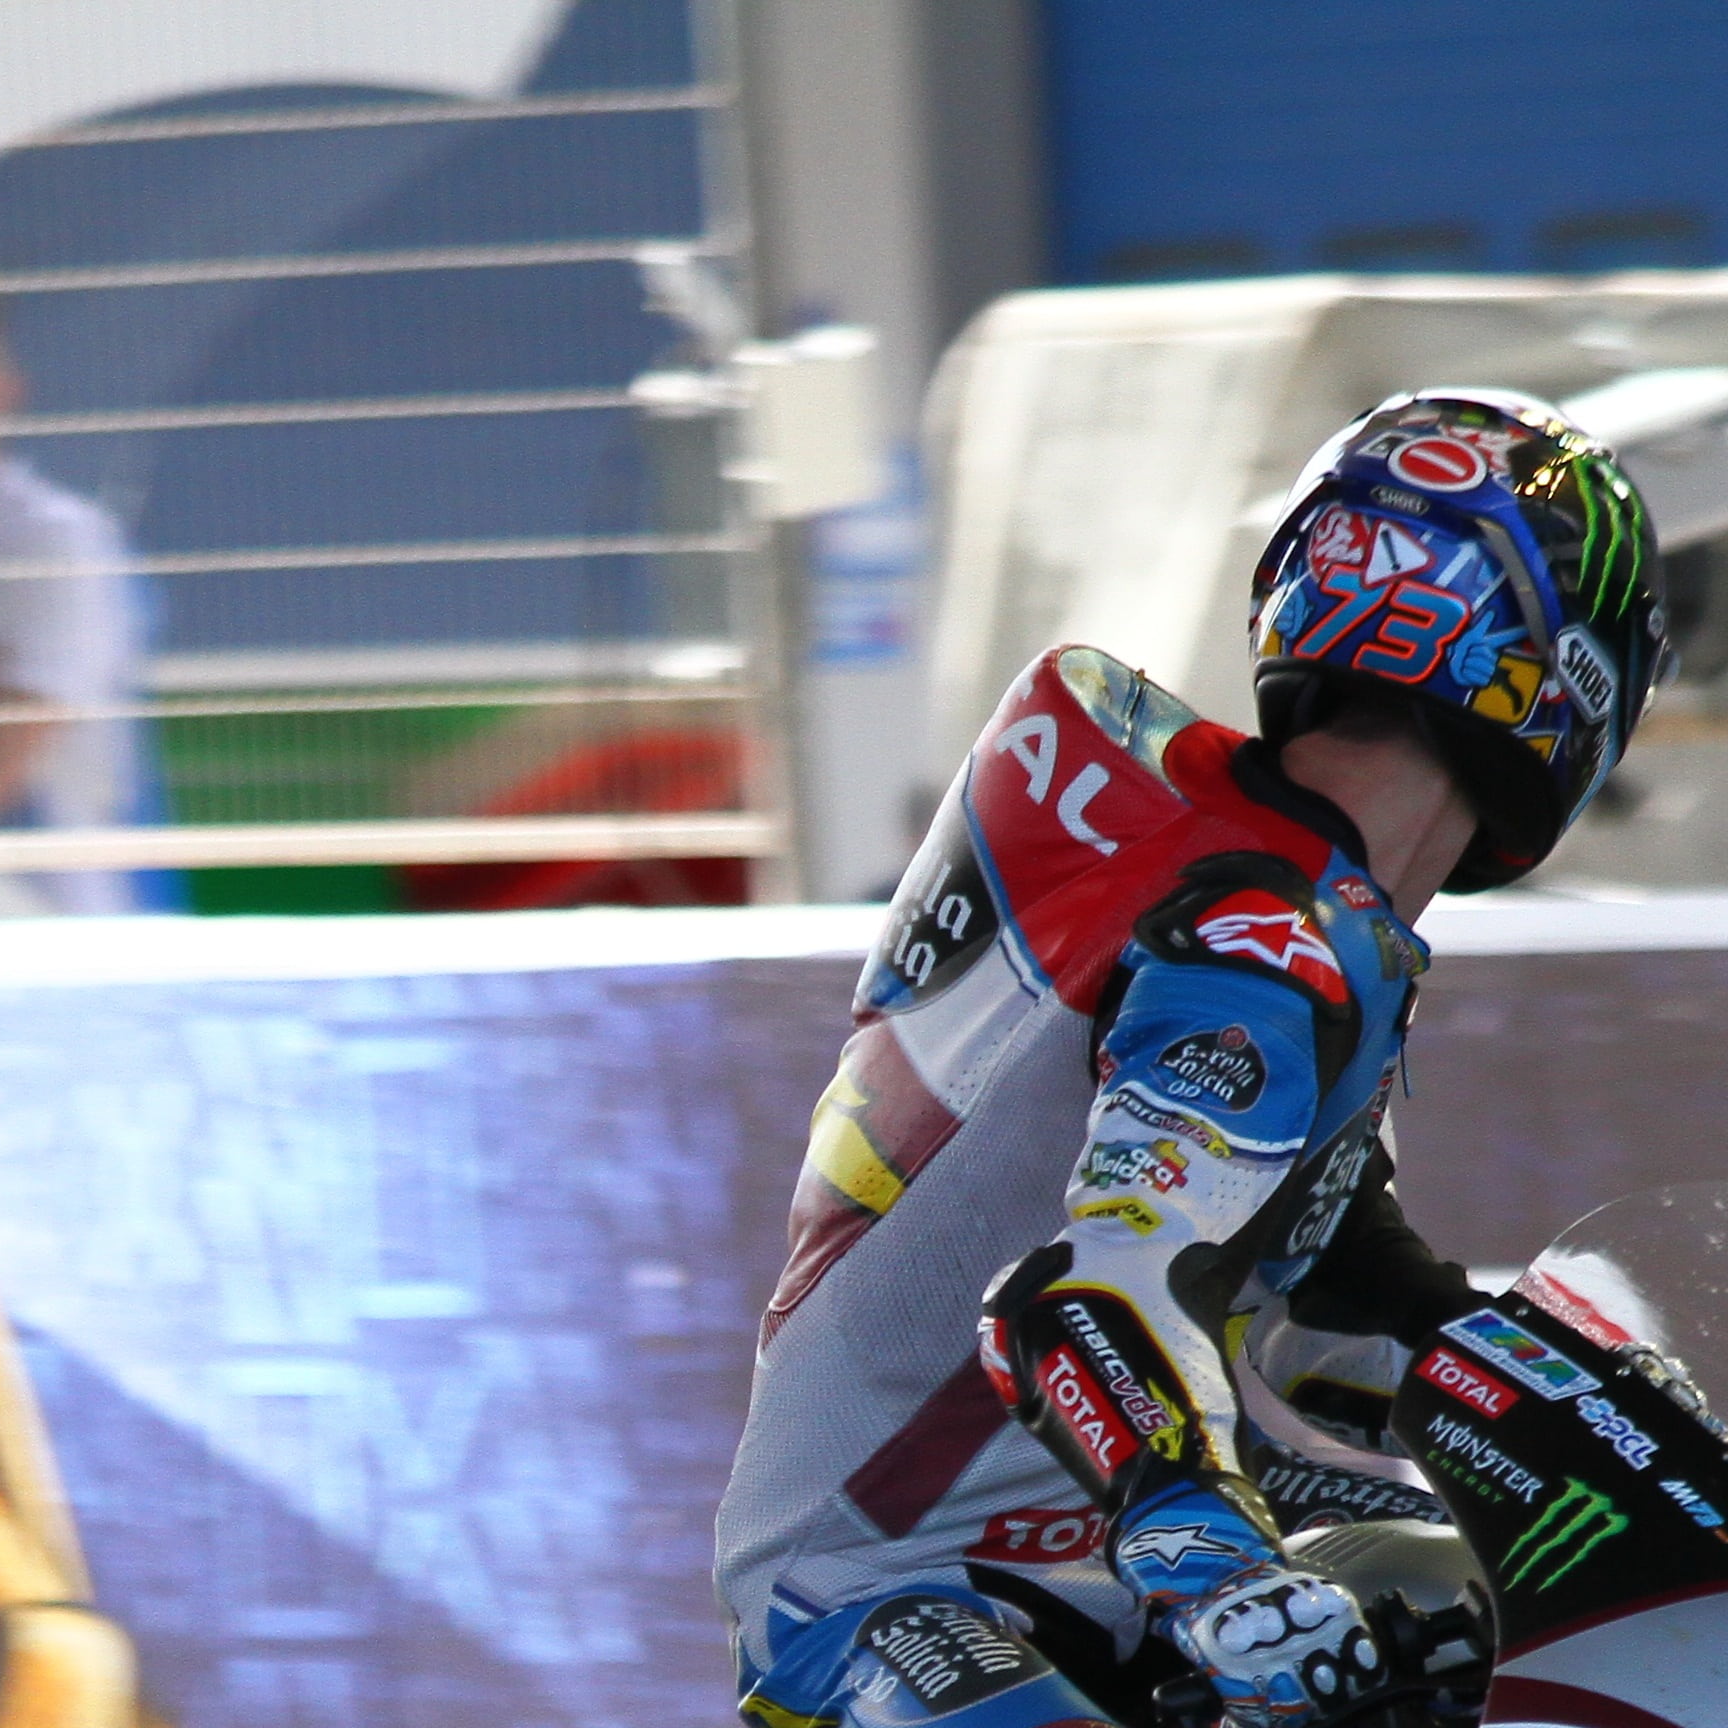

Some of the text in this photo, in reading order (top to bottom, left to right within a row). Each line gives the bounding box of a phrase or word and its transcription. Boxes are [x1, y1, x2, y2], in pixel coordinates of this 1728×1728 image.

[1293, 563, 1471, 684] 73
[1562, 637, 1614, 713] SHOEI
[993, 713, 1119, 856] AL
[1046, 1352, 1116, 1469] TOTAL
[1429, 1352, 1501, 1413] TOTAL
[1427, 1413, 1545, 1504] MONSTER
[1004, 1512, 1111, 1553] TOT
